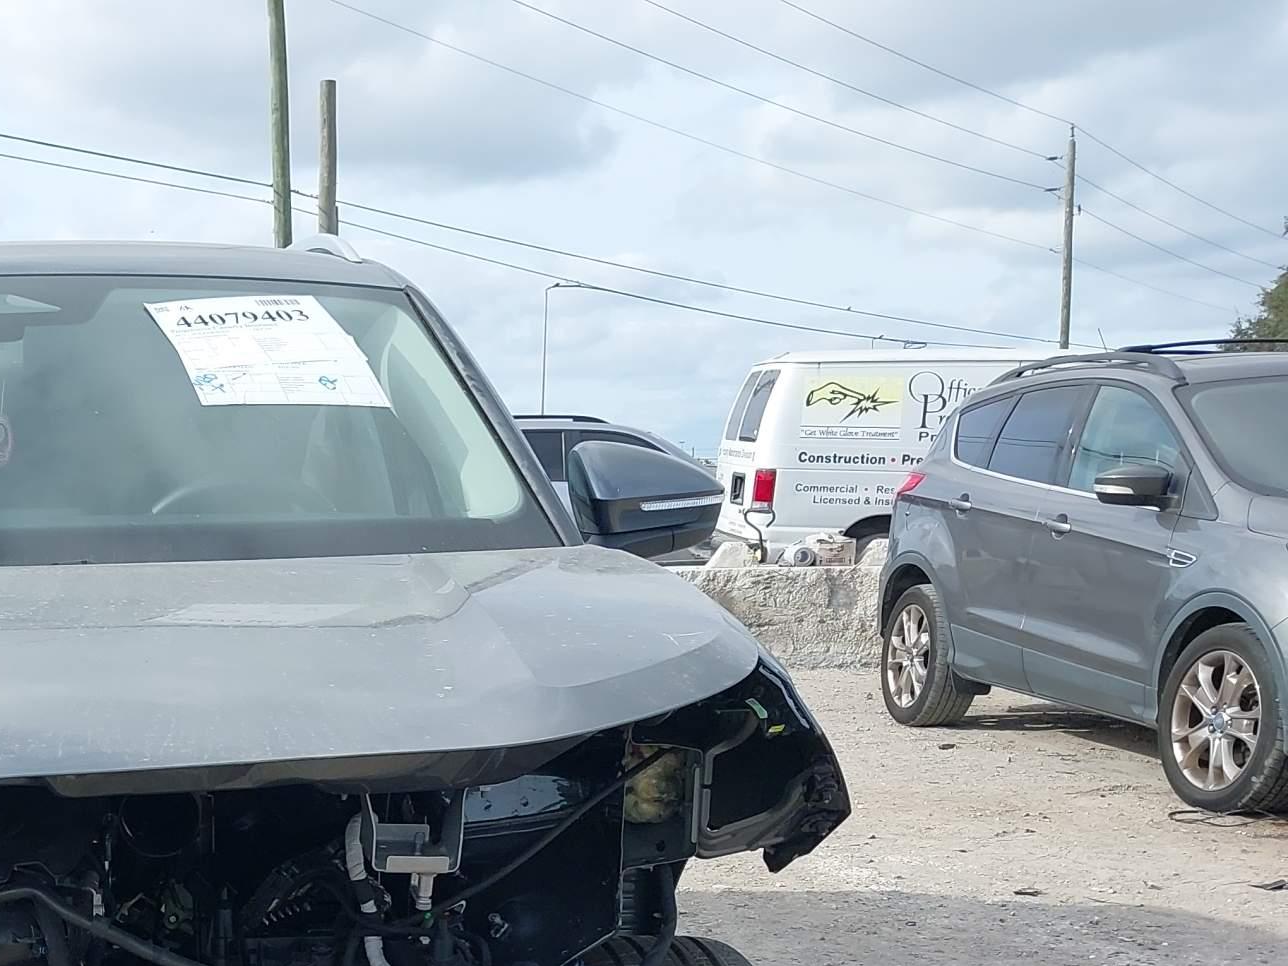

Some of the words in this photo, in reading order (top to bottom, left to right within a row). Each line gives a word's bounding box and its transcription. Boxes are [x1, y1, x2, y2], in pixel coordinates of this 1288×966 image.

[176, 308, 310, 328] 44079403
[908, 371, 983, 404] Offic
[797, 451, 887, 466] Construction
[794, 483, 859, 494] Commercial
[812, 495, 861, 506] Licensed
[863, 496, 871, 506] &
